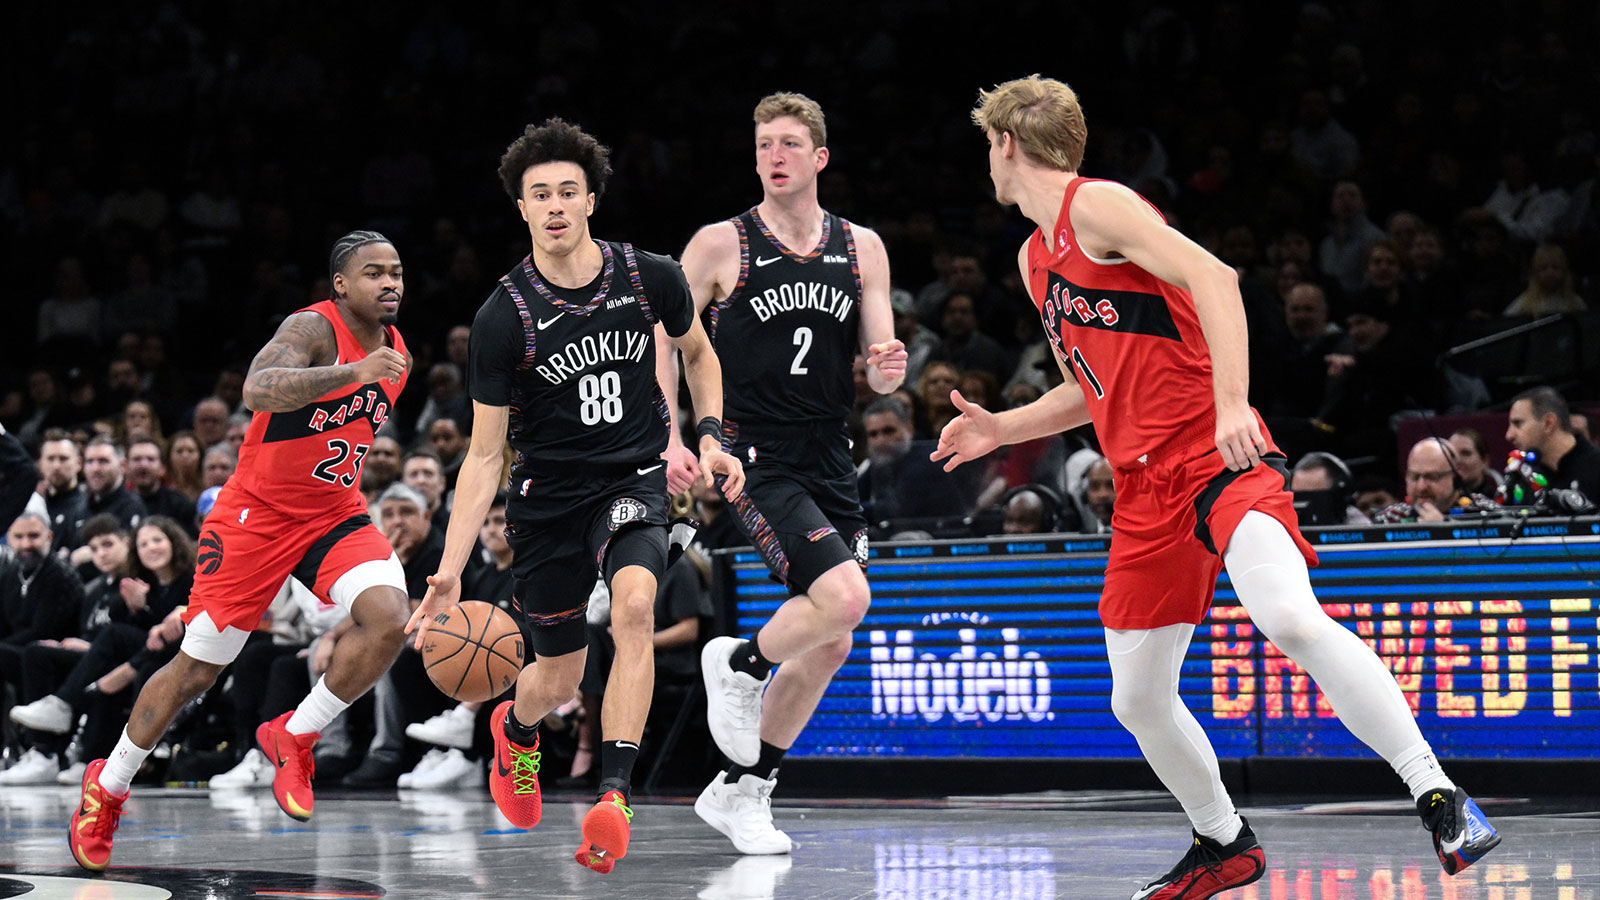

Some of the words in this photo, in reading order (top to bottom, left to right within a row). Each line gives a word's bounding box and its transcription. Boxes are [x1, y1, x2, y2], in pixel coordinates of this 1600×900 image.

[606, 299, 615, 311] All
[749, 281, 854, 323] BROOKLYN
[535, 330, 650, 386] BROOKLYN
[789, 326, 813, 375] 2
[1072, 346, 1104, 400] 1
[578, 370, 623, 426] 88
[311, 438, 370, 488] 23
[1551, 598, 1600, 717] F
